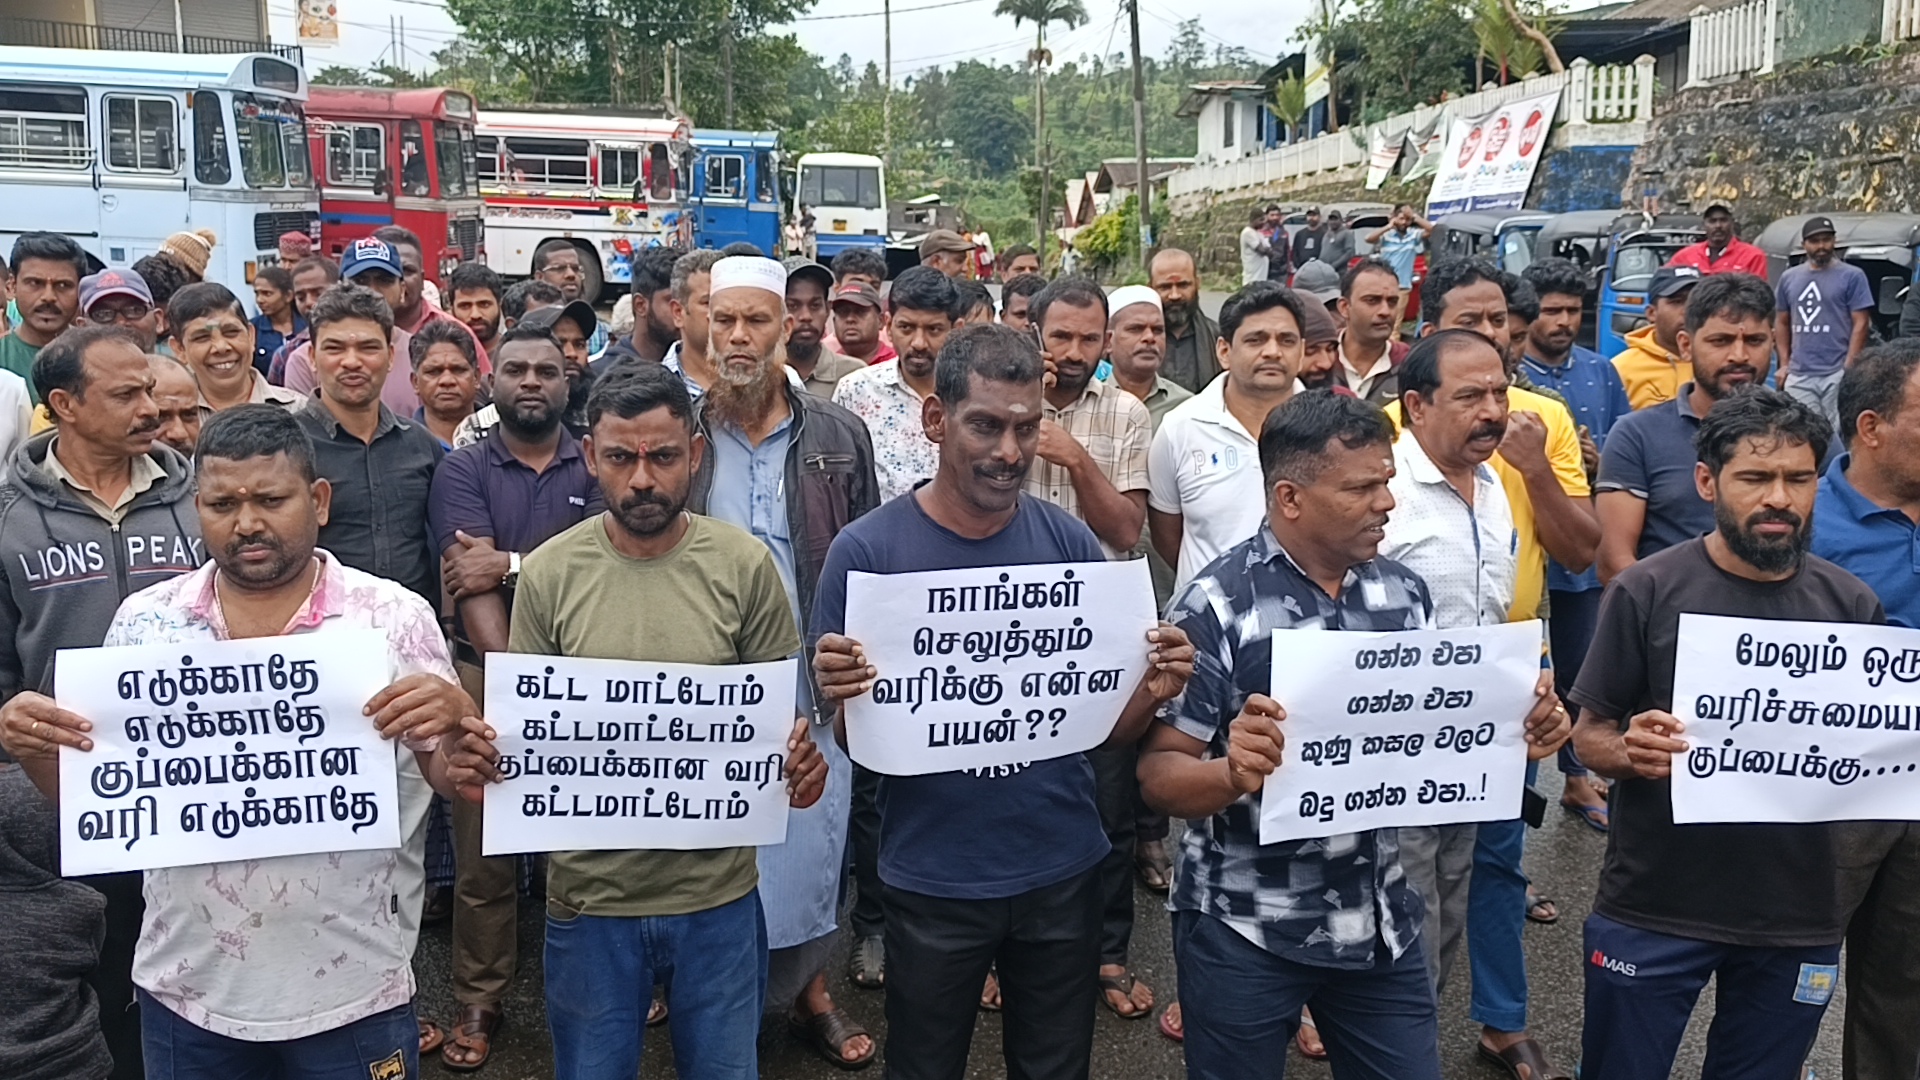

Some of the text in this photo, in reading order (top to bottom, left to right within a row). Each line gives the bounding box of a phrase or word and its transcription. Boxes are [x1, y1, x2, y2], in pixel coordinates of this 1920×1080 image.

[18, 535, 202, 582] LIONS PEAK
[926, 569, 1085, 613] நாங்கள்
[913, 617, 1093, 665] செலுத்தும்
[1354, 640, 1482, 670] ගන්න එපා
[1736, 633, 1847, 678] மேலும்
[117, 653, 319, 706] எடுக்காதே
[516, 666, 765, 707] கட்ட மாட்டோம்
[872, 660, 1126, 715] வரிக்கு என்ன
[1347, 687, 1473, 715] ගන්න එපා
[124, 700, 326, 748] எடுக்காதே
[522, 710, 755, 744] கட்டமாட்டோம்
[927, 707, 1067, 748] பயன்??
[1301, 722, 1495, 766] කුණු කසල වලට
[91, 741, 362, 799] குப்பைக்கான
[725, 753, 784, 791] வரி
[78, 785, 379, 851] வரி எடுக்காதே
[521, 785, 750, 820] கட்டமாட்டோம்
[1298, 791, 1335, 823] බදු
[1344, 782, 1407, 813] ගන්න
[1602, 955, 1637, 977] MAS
